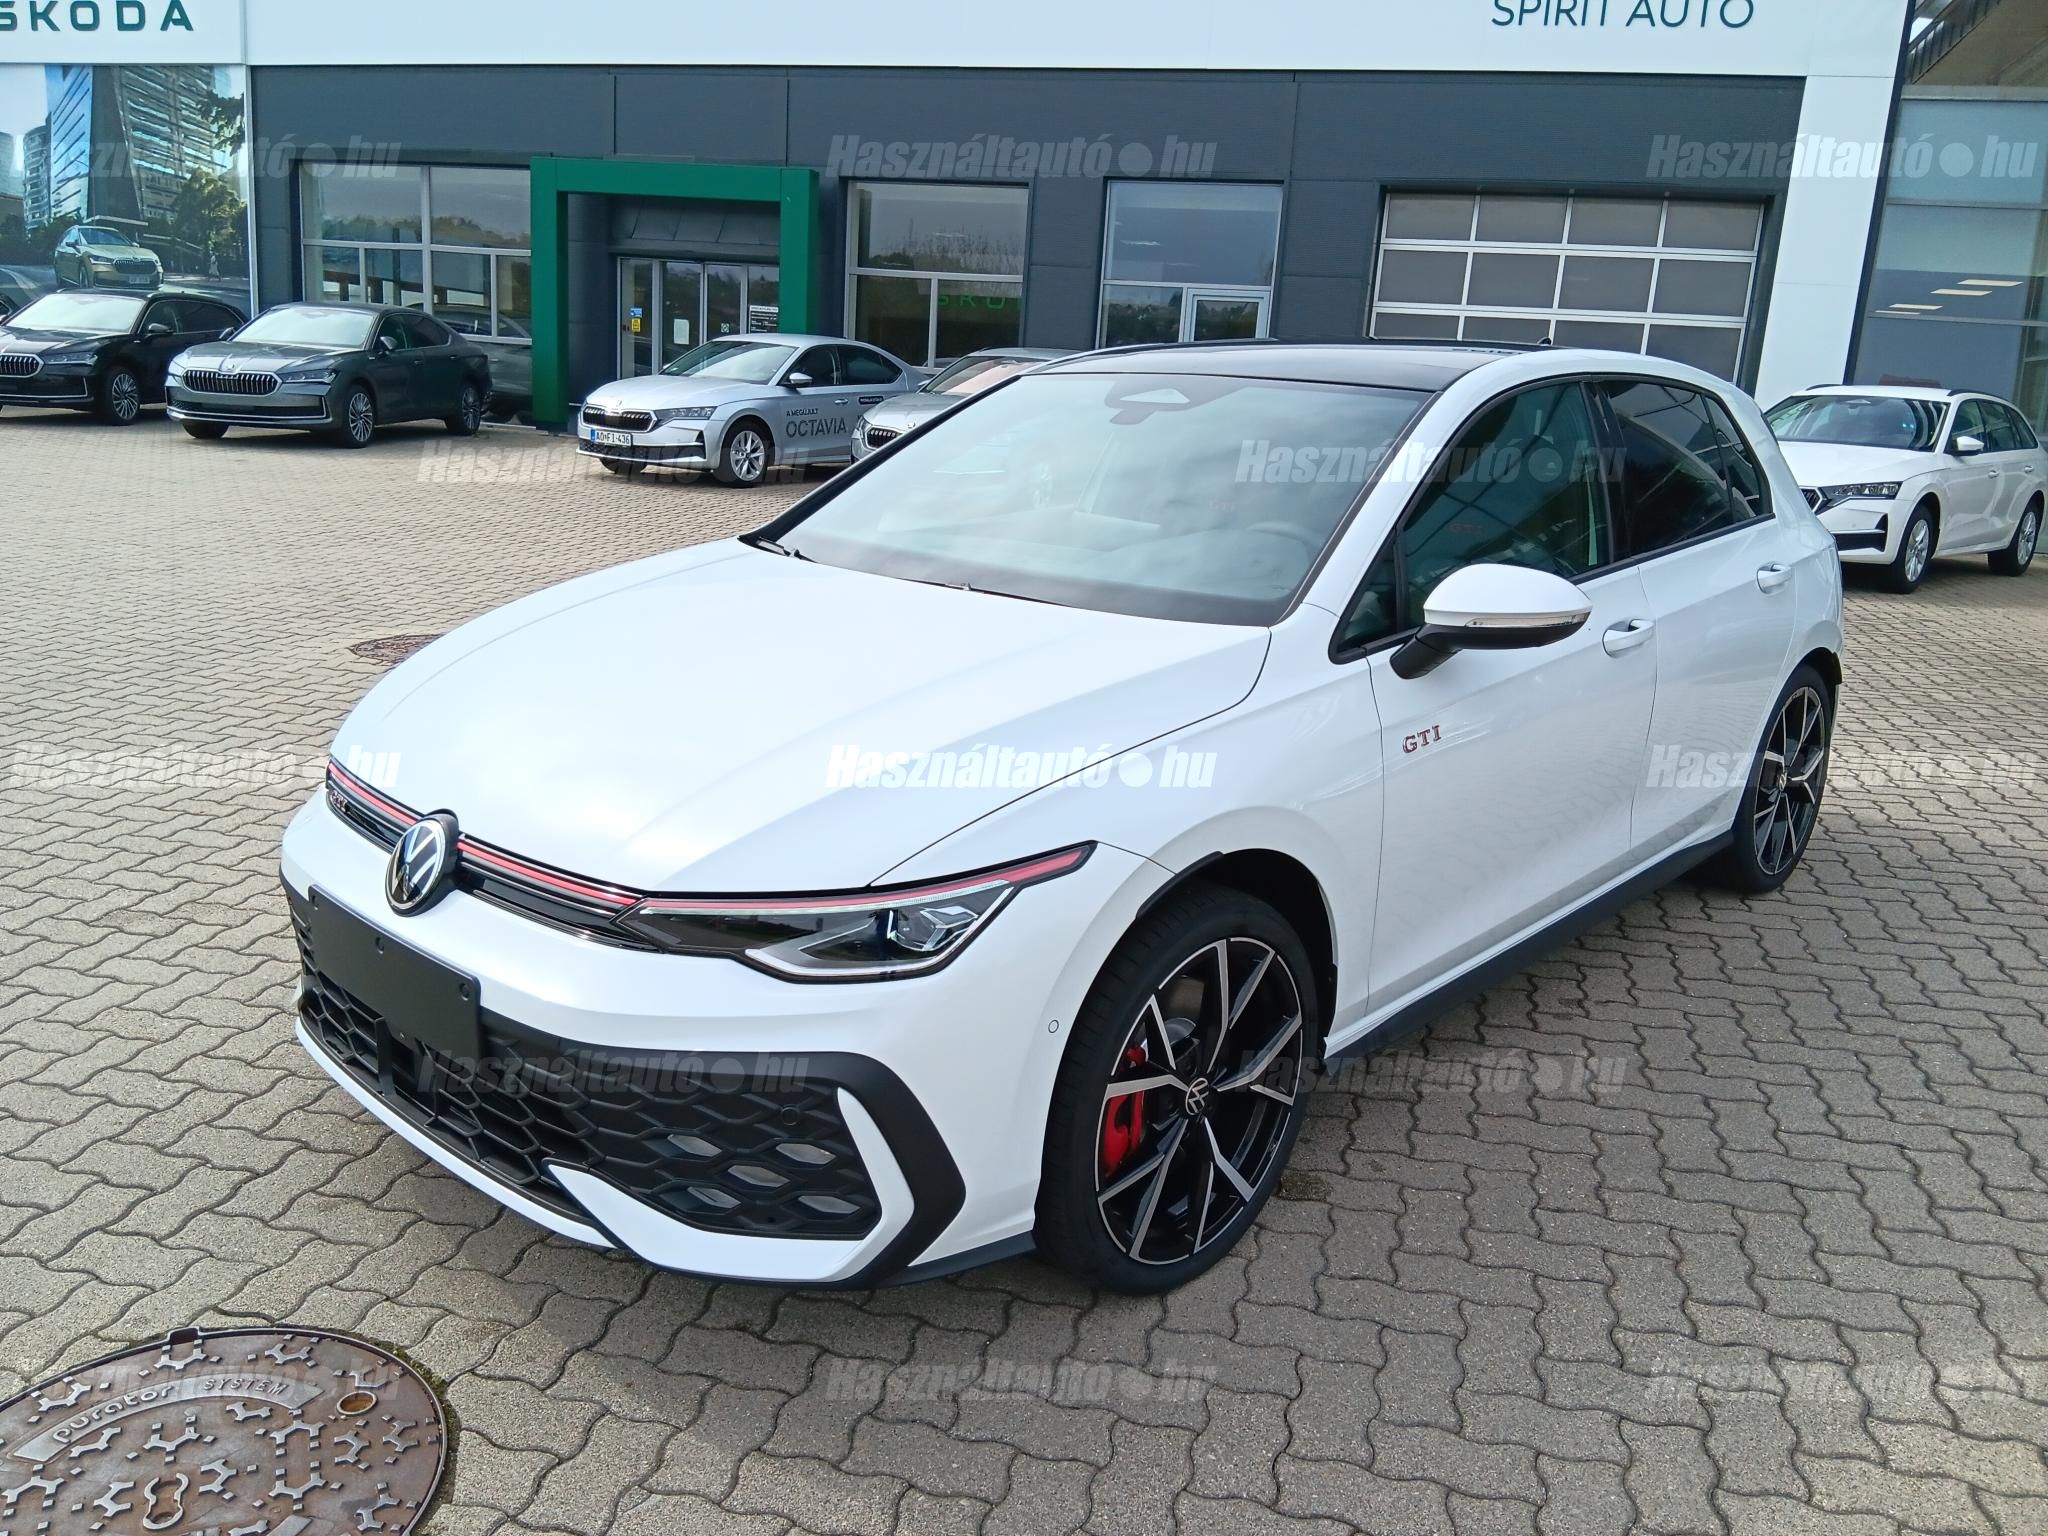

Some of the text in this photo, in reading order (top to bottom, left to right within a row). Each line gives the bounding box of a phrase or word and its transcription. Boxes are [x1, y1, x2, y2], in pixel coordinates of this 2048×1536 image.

[1625, 0, 1754, 28] AUTO
[786, 417, 847, 438] OCTAVIA
[1402, 724, 1442, 754] GTI
[52, 1378, 289, 1444] purator SYSTEM
